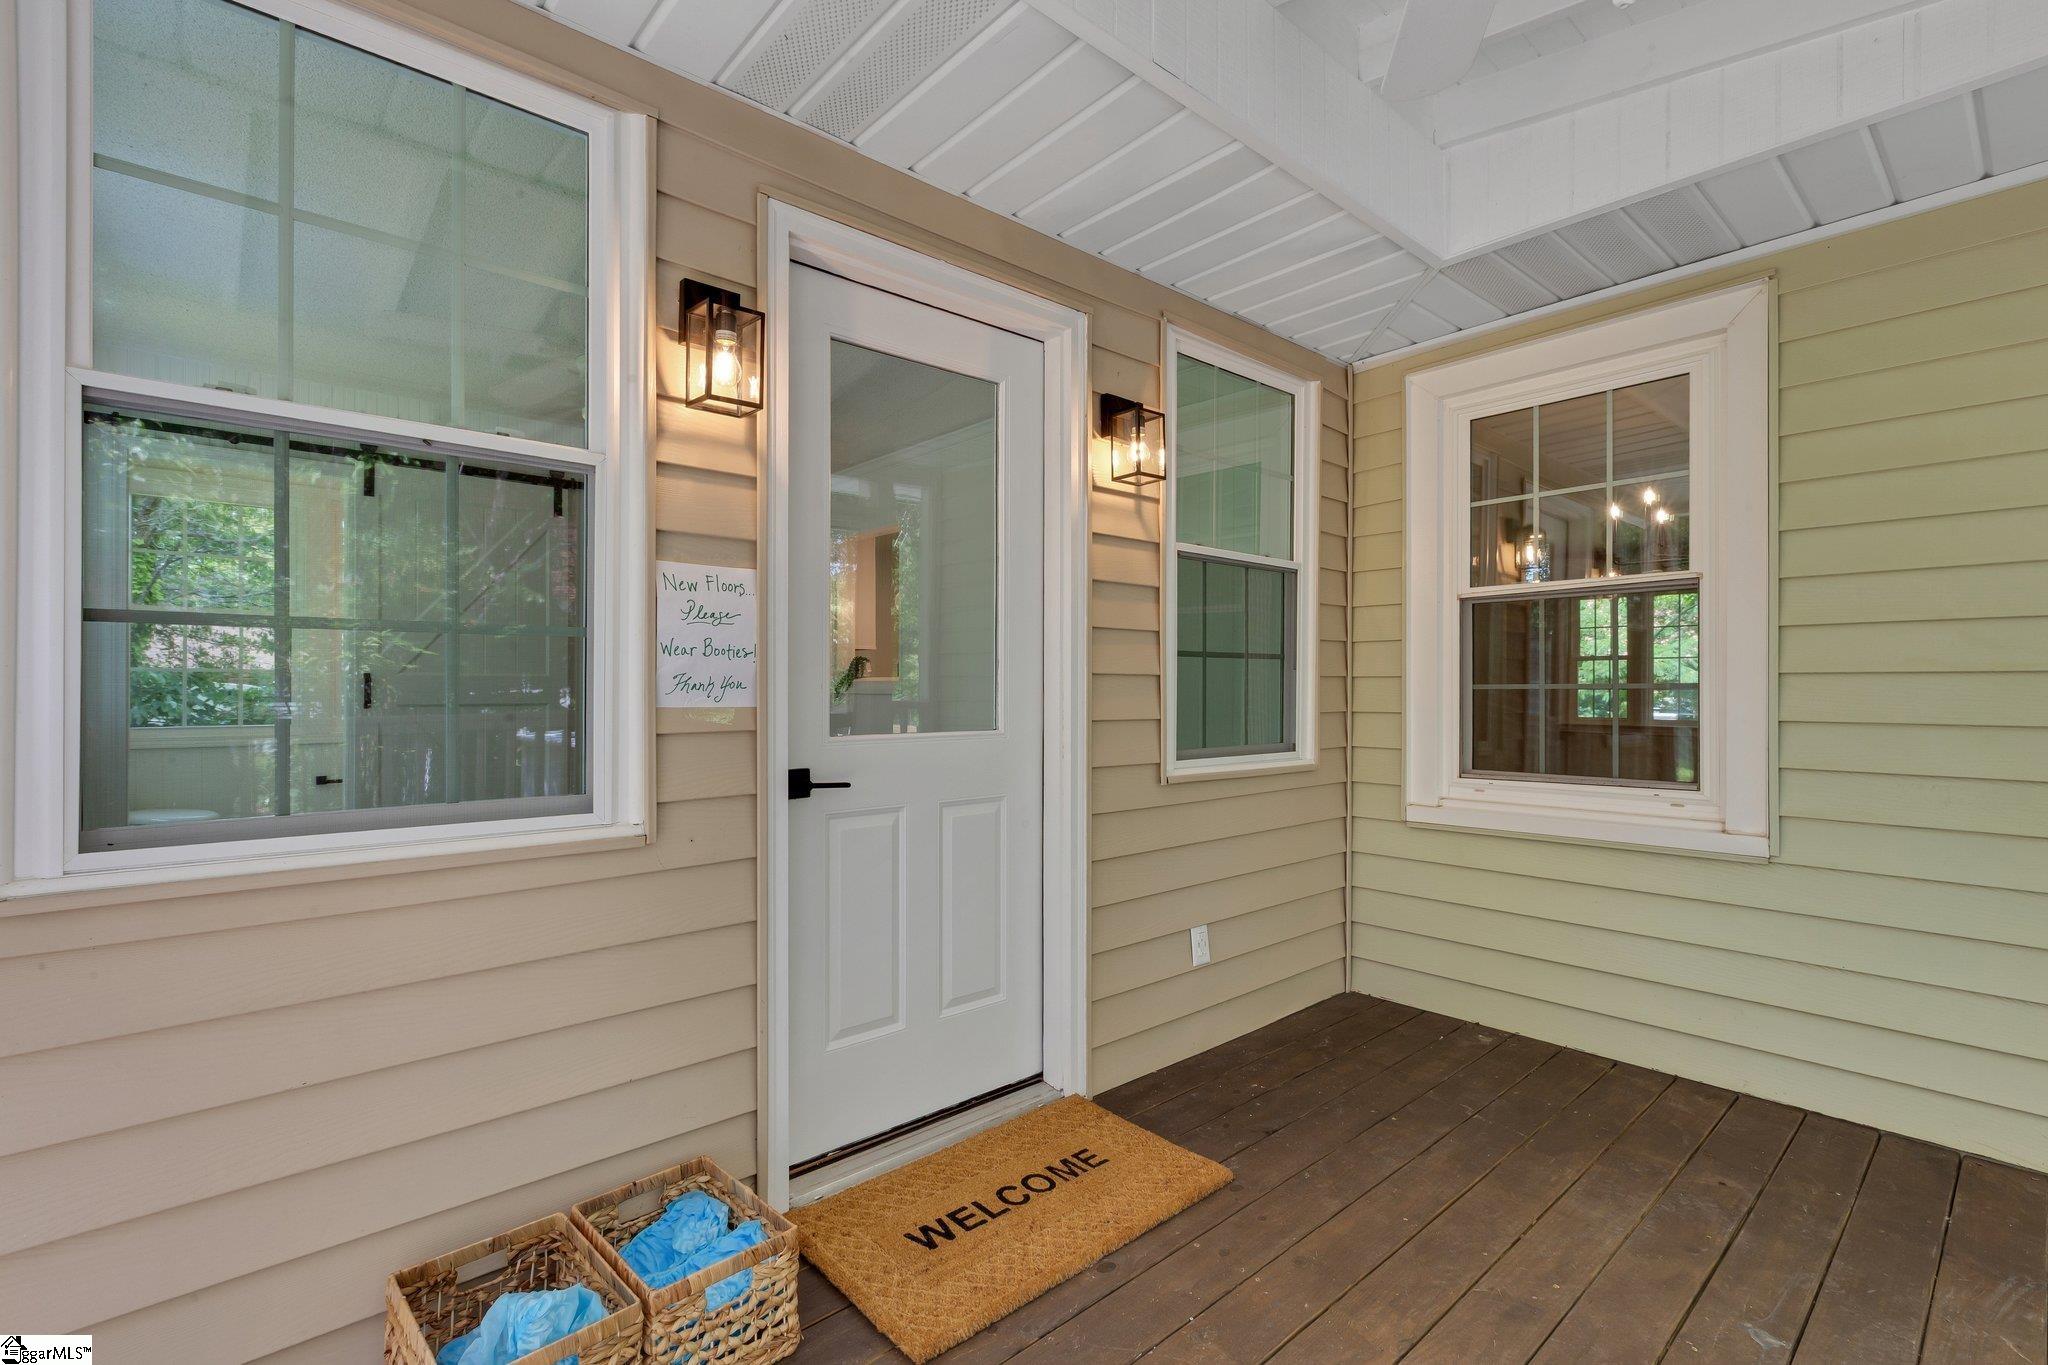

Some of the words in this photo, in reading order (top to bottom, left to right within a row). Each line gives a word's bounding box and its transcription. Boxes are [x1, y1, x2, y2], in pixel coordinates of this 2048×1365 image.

[662, 572, 698, 592] New
[680, 599, 741, 627] Please
[660, 637, 697, 657] Wear
[702, 637, 757, 664] Booties!
[665, 672, 714, 699] Thank
[713, 675, 747, 703] You
[903, 1148, 1110, 1250] WELCOME
